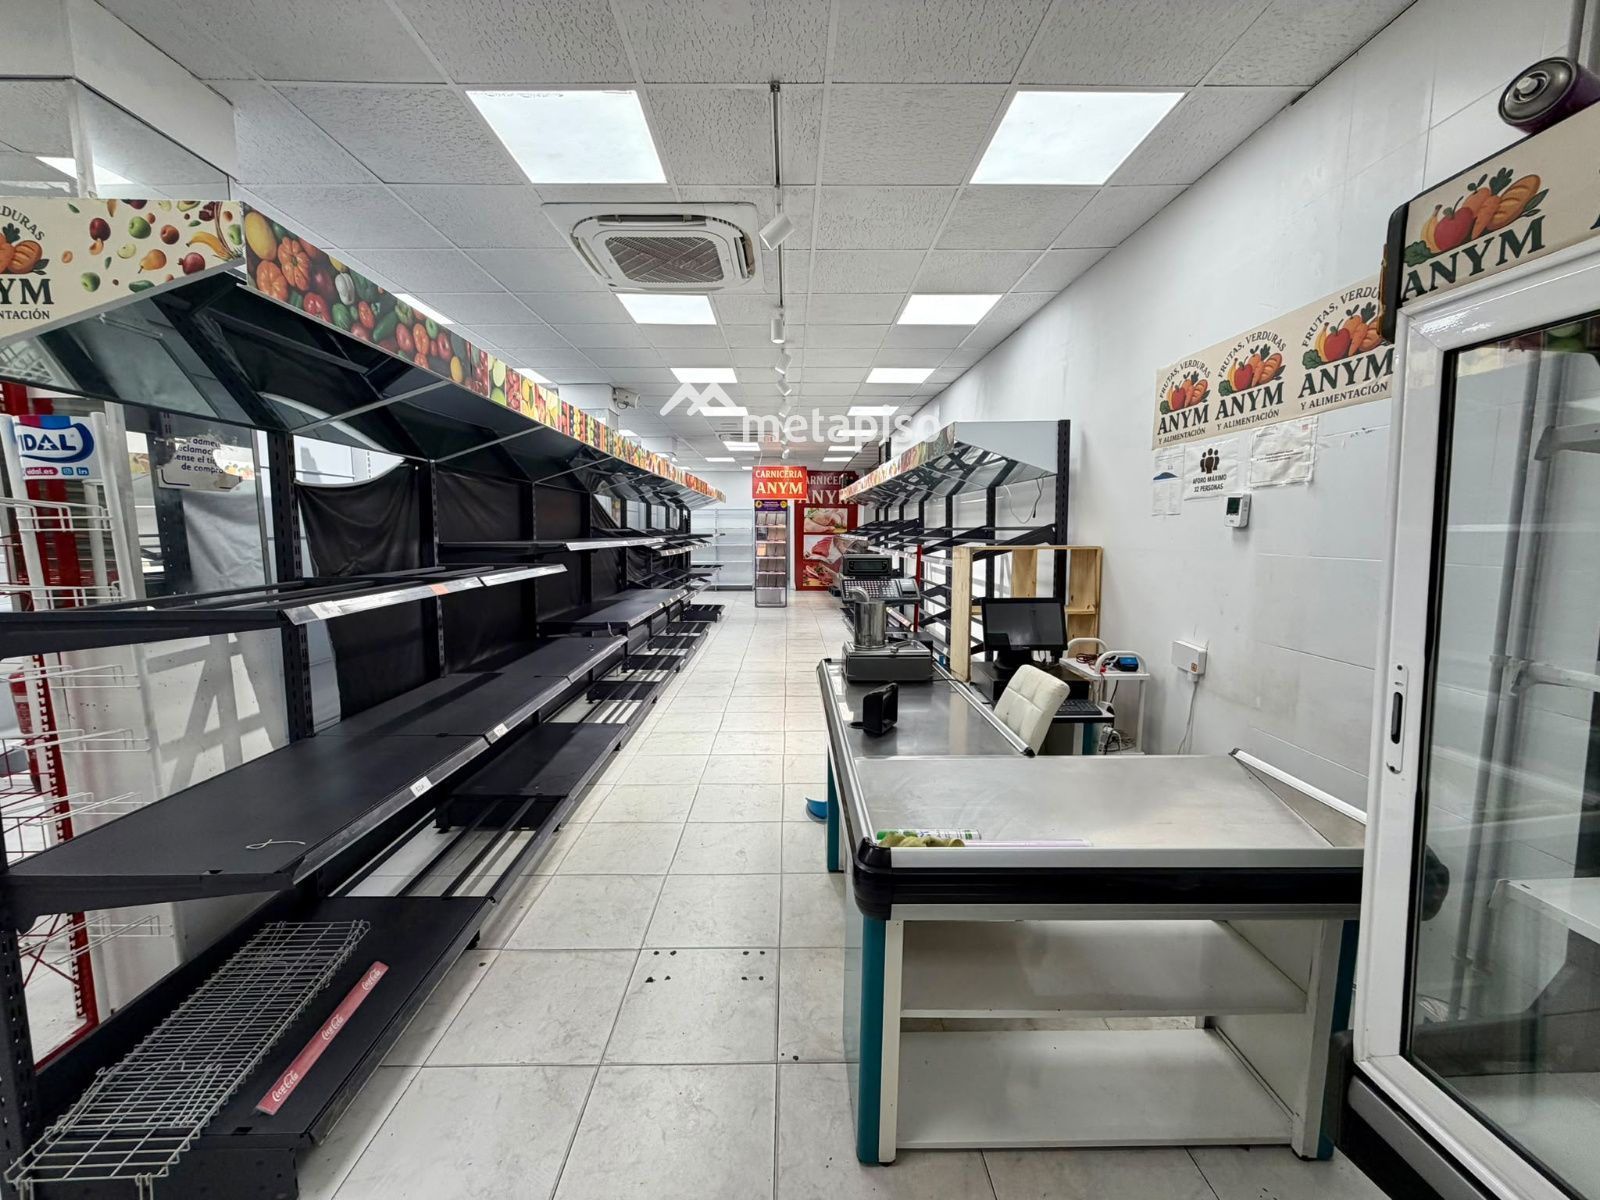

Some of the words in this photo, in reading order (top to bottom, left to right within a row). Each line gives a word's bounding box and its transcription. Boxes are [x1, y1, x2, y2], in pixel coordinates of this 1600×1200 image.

[0, 205, 45, 241] DURAS
[1400, 215, 1547, 303] ANYM
[1302, 302, 1338, 347] FRUTAS,
[1340, 286, 1380, 304] VERDU
[1245, 330, 1286, 352] VERDURAS
[1180, 360, 1211, 378] VERDURAS
[1297, 347, 1395, 398] ANYM
[1215, 381, 1284, 420] ANYM
[1300, 401, 1307, 410] Y
[1309, 381, 1388, 408] ALIMENTACIÓN
[1157, 403, 1209, 435] ANYM
[1216, 423, 1221, 431] Y
[1223, 409, 1280, 430] ALIMENTACIÓN
[1164, 427, 1206, 443] ALIMENTACIÓN
[181, 463, 192, 471] de
[755, 470, 803, 479] CARNICERIA
[756, 482, 803, 494] ANYM
